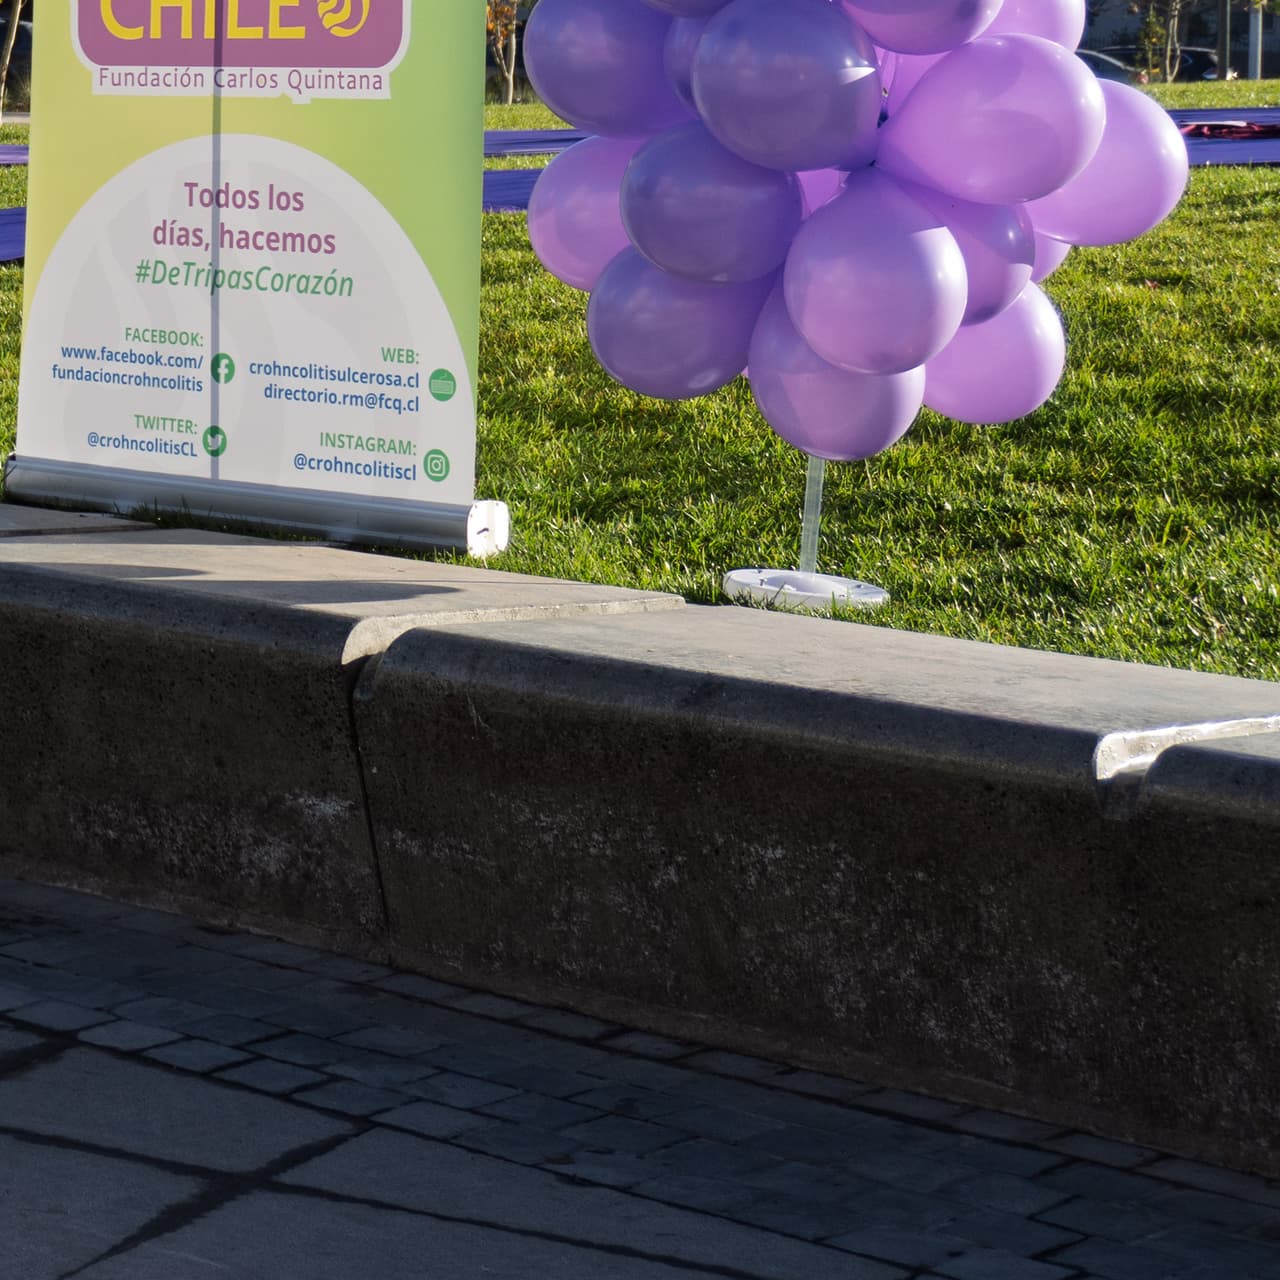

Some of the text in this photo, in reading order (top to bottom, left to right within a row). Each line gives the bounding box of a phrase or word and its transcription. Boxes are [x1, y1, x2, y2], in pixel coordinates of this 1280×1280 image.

[98, 67, 384, 96] Fundación Carlos Quintana
[183, 181, 305, 213] Todos los
[152, 219, 337, 256] días, hacemos
[135, 259, 354, 298] #DeTripasCorazón
[124, 326, 204, 348] FACEBOOK:
[61, 345, 204, 370] www.facebook.com/
[380, 346, 420, 365] WEB:
[52, 363, 204, 393] fundacioncrohncolitis
[249, 360, 420, 389] crohncolitisulcerosa.cl
[263, 383, 420, 415] directorio.rm@fcq.cl
[134, 414, 198, 436] TWITTER:
[87, 431, 198, 458] @crohncolitisCL
[320, 431, 417, 457] INSTAGRAM:
[293, 453, 417, 482] @crohncolitiscl
